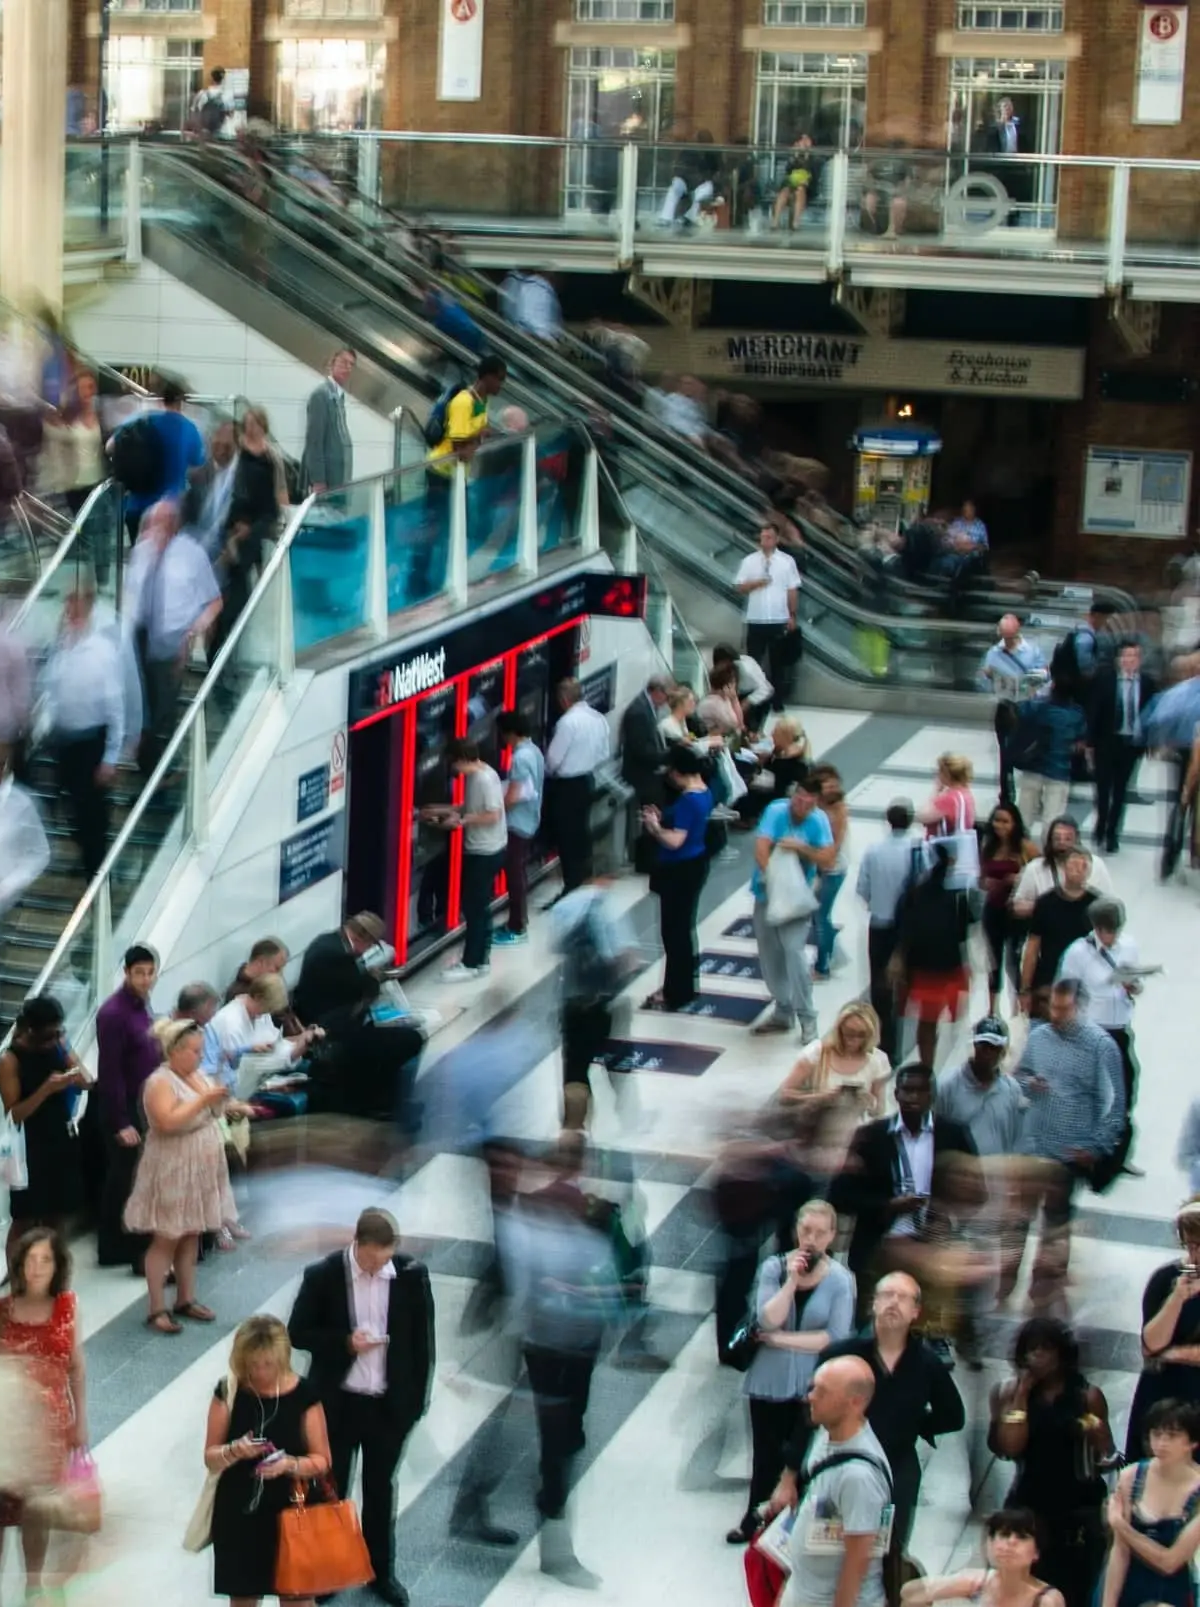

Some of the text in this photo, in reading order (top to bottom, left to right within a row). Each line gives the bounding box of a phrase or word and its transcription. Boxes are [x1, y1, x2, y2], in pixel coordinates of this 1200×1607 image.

[456, 0, 471, 17] A
[727, 334, 864, 366] MERCHANT
[394, 646, 445, 703] NatWest
